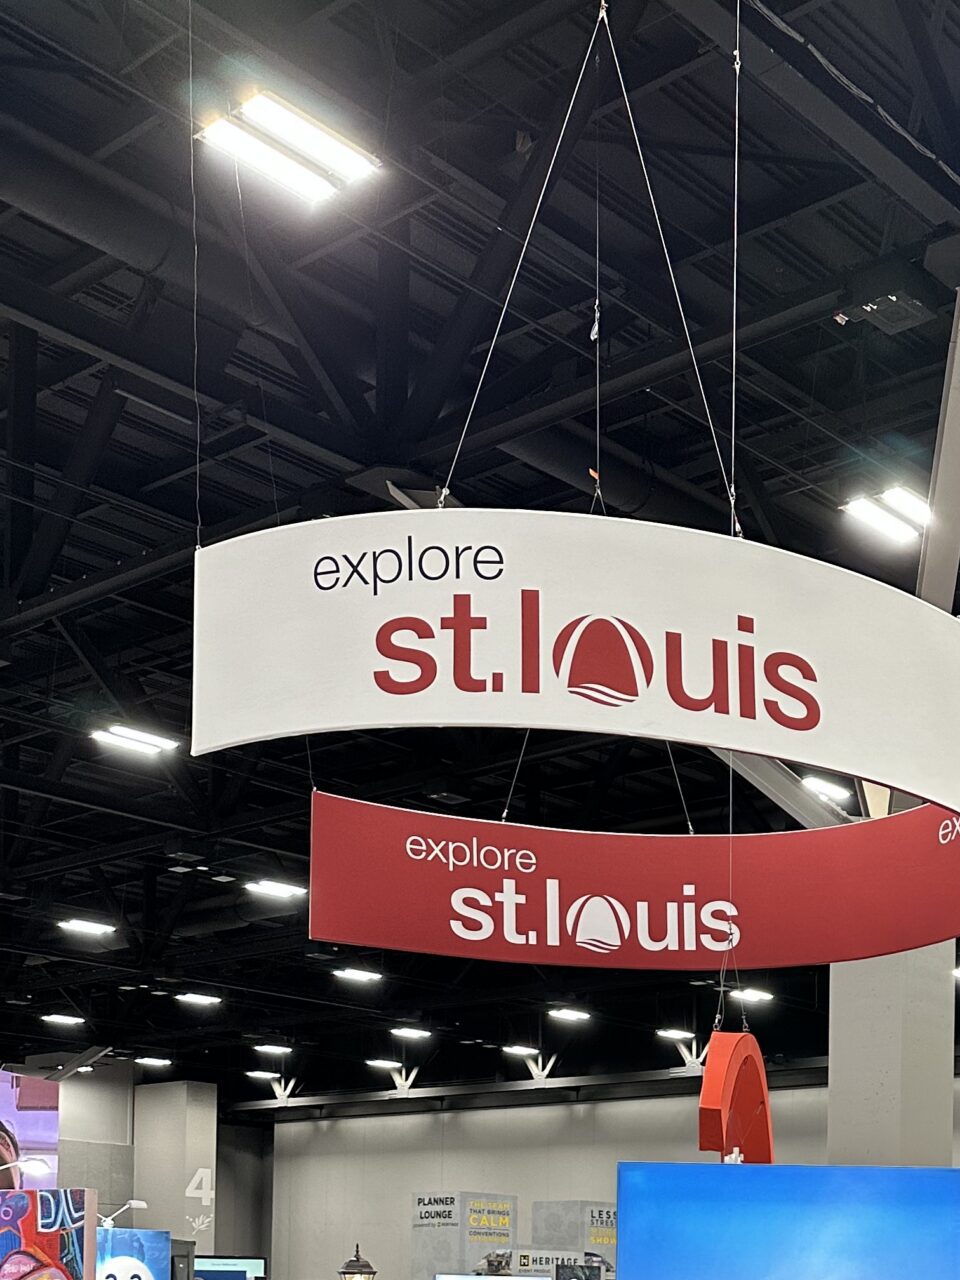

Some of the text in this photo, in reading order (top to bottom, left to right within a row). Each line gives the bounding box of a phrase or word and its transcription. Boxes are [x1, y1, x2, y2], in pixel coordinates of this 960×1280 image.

[313, 536, 505, 594] explore
[373, 589, 821, 731] st.louis
[404, 833, 538, 872] explore
[449, 878, 740, 952] st.louis
[185, 1167, 215, 1206] 4
[417, 1197, 456, 1206] PLANNER
[419, 1210, 453, 1219] LOUNGE
[468, 1214, 510, 1227] CALM
[531, 1256, 579, 1265] HERITAGE
